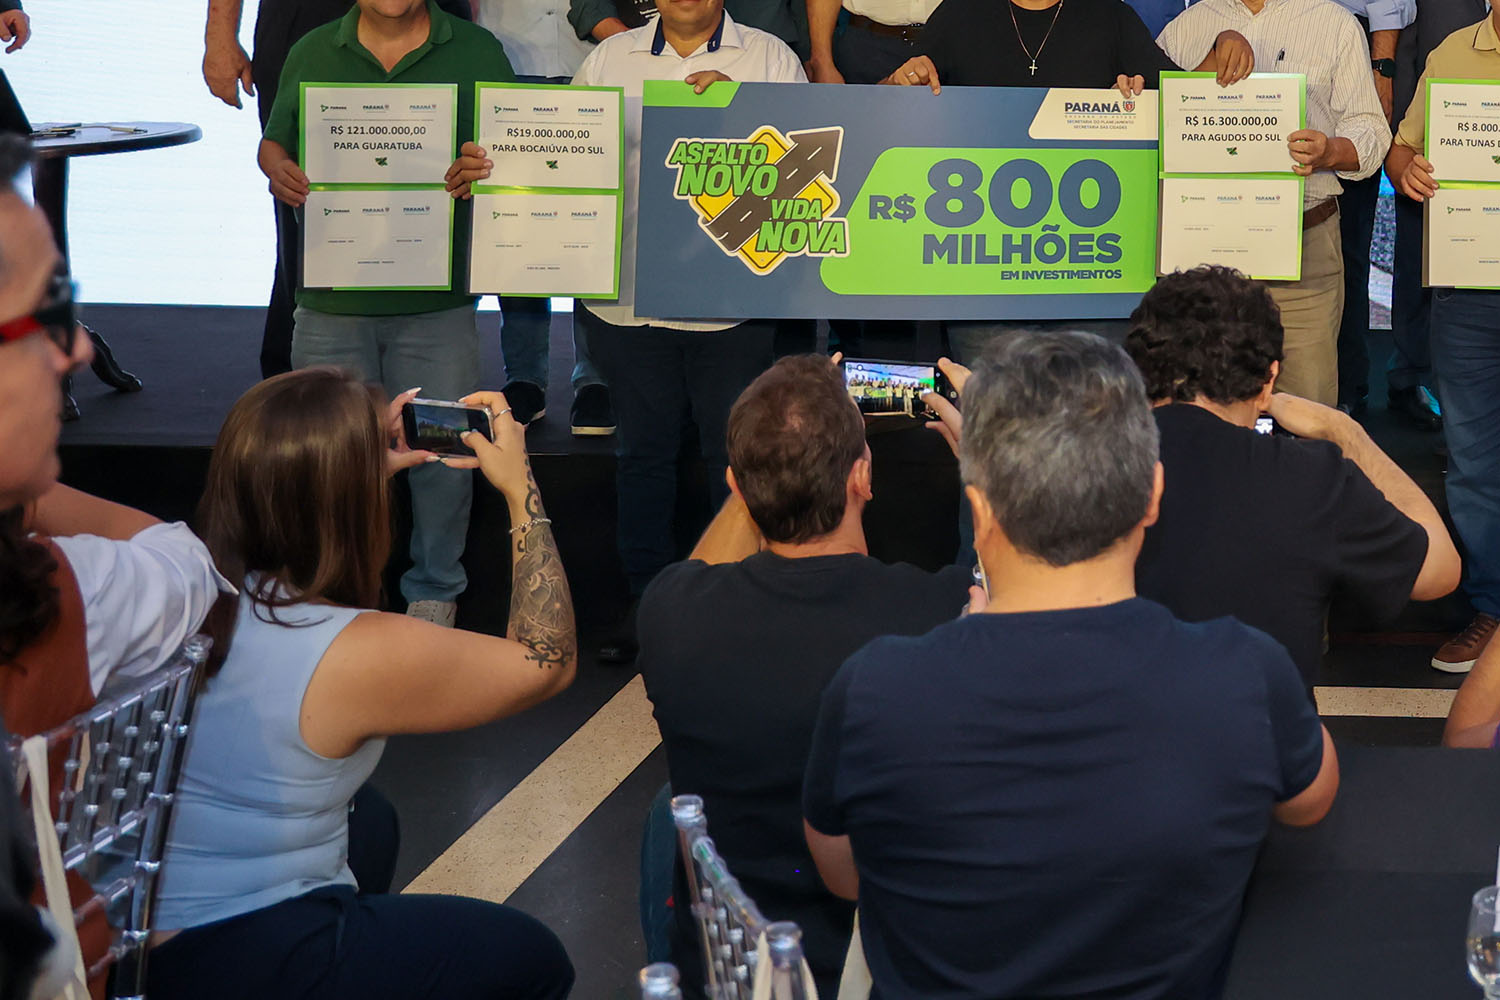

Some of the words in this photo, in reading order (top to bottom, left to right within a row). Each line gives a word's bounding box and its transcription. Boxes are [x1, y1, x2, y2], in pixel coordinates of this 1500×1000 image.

[1065, 101, 1120, 112] PARANÁ
[1186, 116, 1198, 126] R$
[1203, 117, 1277, 127] 16.300.000,00
[1458, 122, 1469, 131] R$
[331, 126, 343, 135] R$
[347, 127, 426, 136] 121.000.000,00
[507, 128, 589, 140] R$19.000.000,00
[334, 142, 359, 150] PARA
[362, 142, 422, 150] GUARATUBA
[1440, 138, 1463, 146] PARA
[1466, 139, 1495, 147] TUNAS
[492, 144, 517, 152] PARA
[520, 144, 568, 153] BOCAIÚVA
[669, 142, 768, 165] ASFALTO
[678, 164, 779, 197] NOVO
[869, 194, 916, 223] R$
[925, 158, 1121, 228] 800
[771, 199, 822, 220] VIDA
[755, 220, 846, 253] NOVA
[923, 224, 1122, 264] MILHÕES
[1001, 271, 1019, 280] EM
[1022, 270, 1122, 280] INVESTIMENTOS
